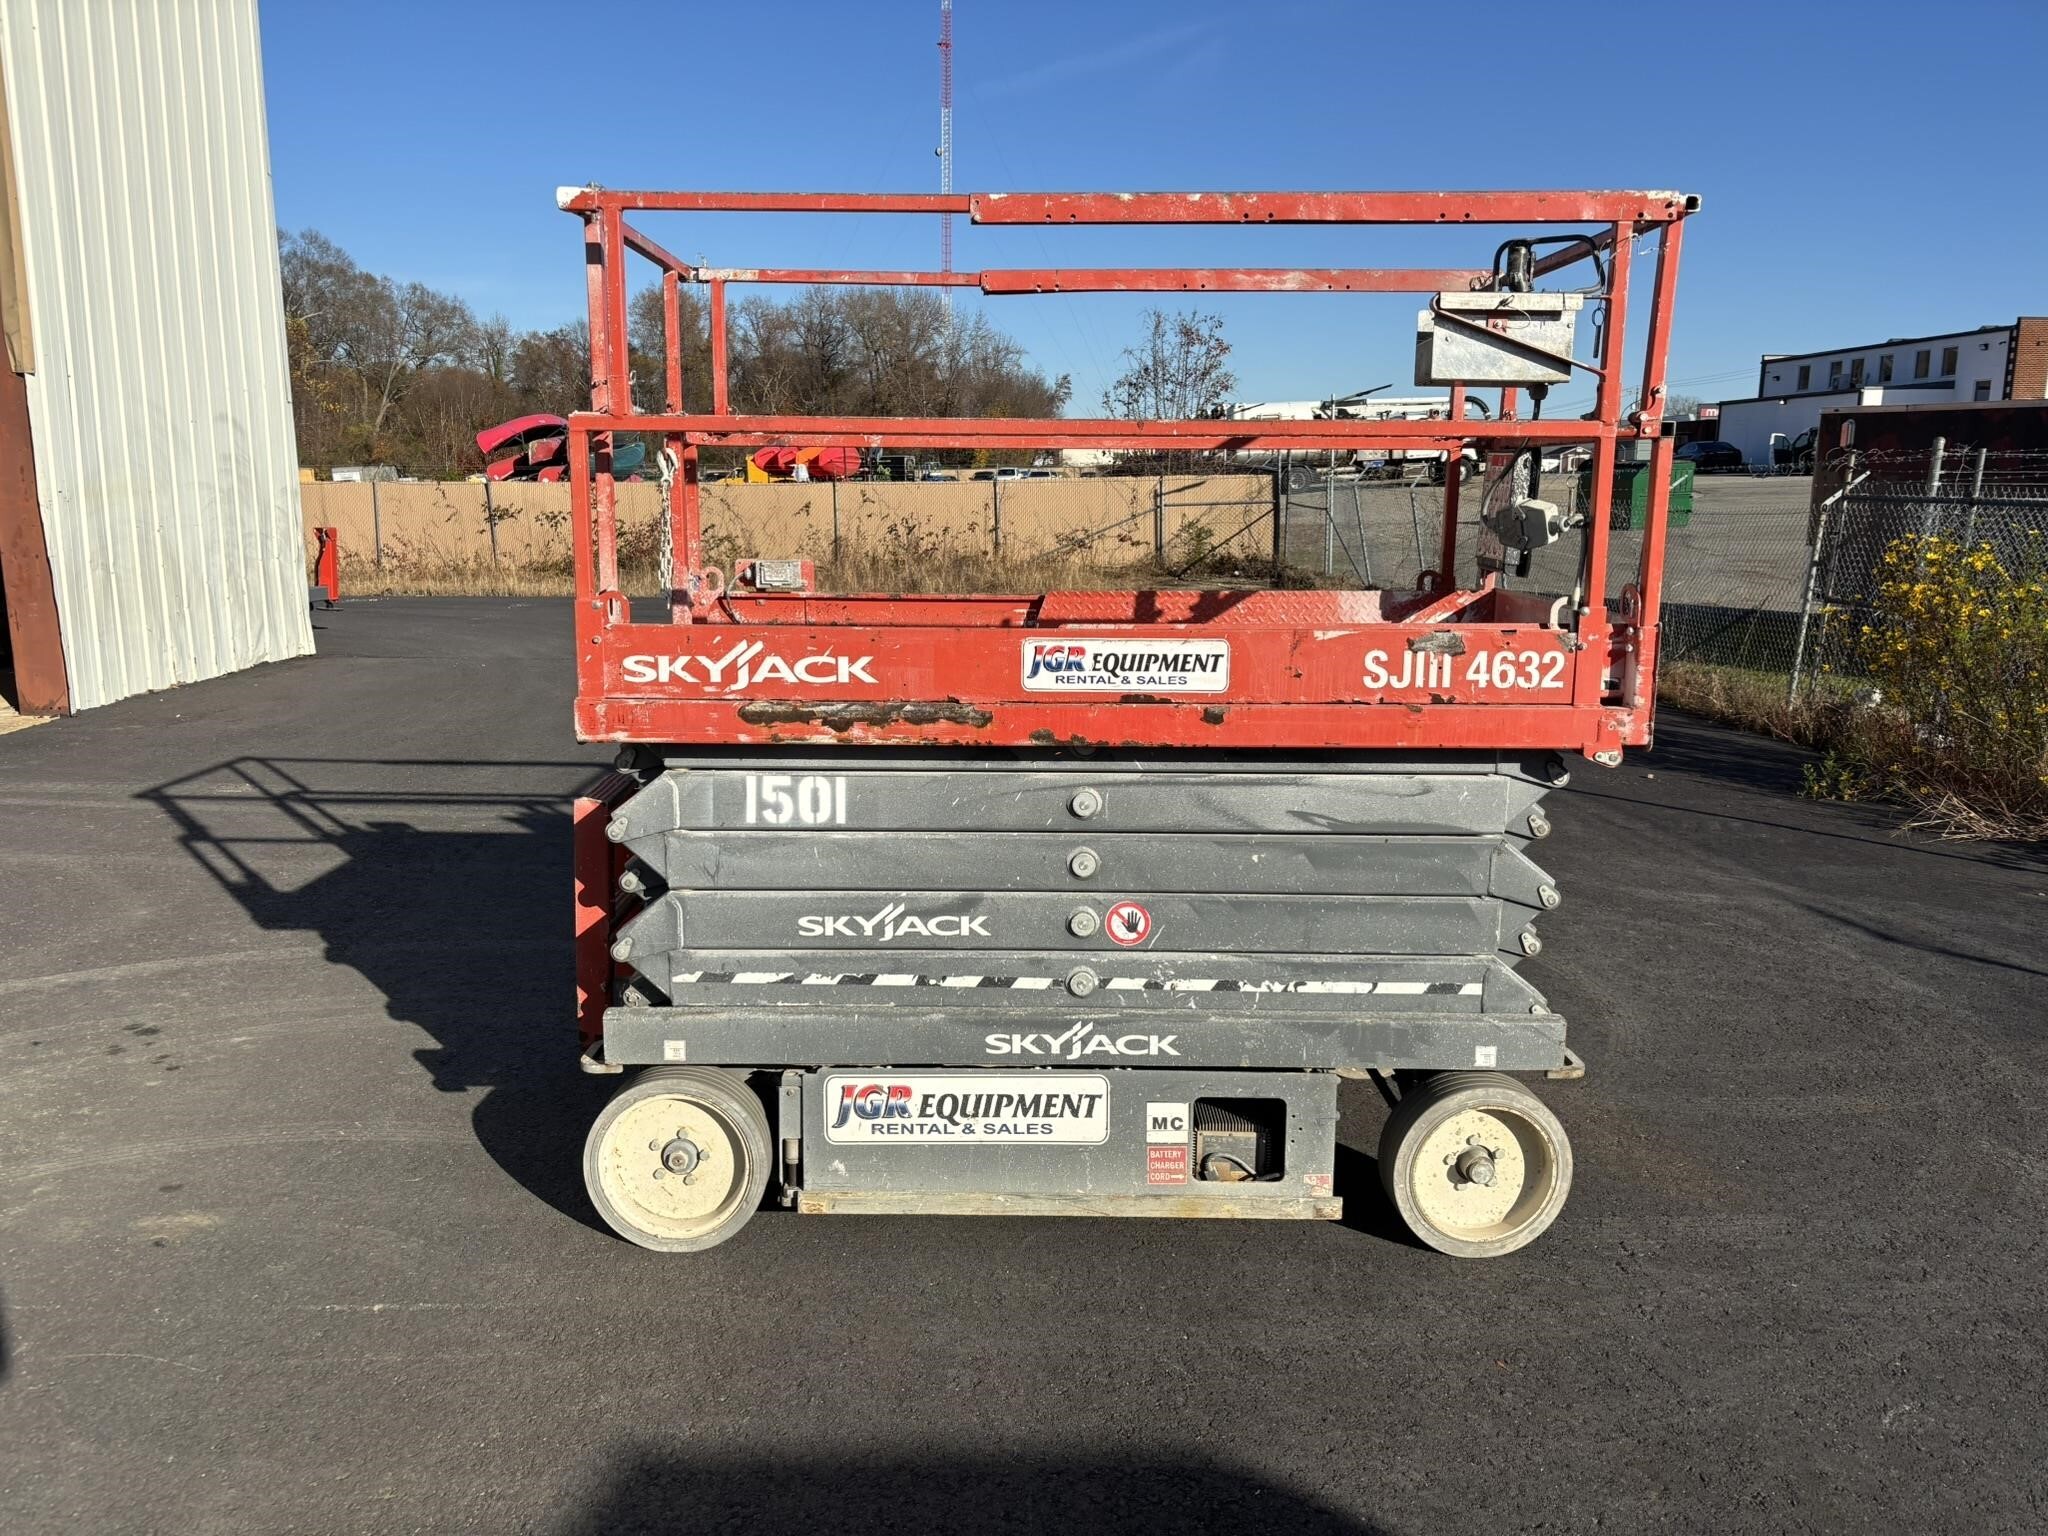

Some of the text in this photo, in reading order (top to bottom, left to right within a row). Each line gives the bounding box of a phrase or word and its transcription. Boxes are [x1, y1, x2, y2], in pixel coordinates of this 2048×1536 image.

[622, 639, 879, 692] SKYJACK
[1027, 645, 1224, 679] JGR EQUIPMENT
[1465, 650, 1566, 689] 4632
[1055, 675, 1188, 685] RENTAL & SALES
[745, 775, 847, 824] 1501
[798, 902, 992, 942] SKYJACK
[985, 1021, 1181, 1060] SKYJACK
[832, 1084, 1104, 1129] JGR EQUIPMENT
[1152, 1116, 1184, 1131] MC
[871, 1122, 1054, 1135] RENTAL & SALES
[1150, 1150, 1183, 1159] BATTERY
[1150, 1161, 1185, 1170] CHARGER
[1150, 1172, 1171, 1181] CORD
